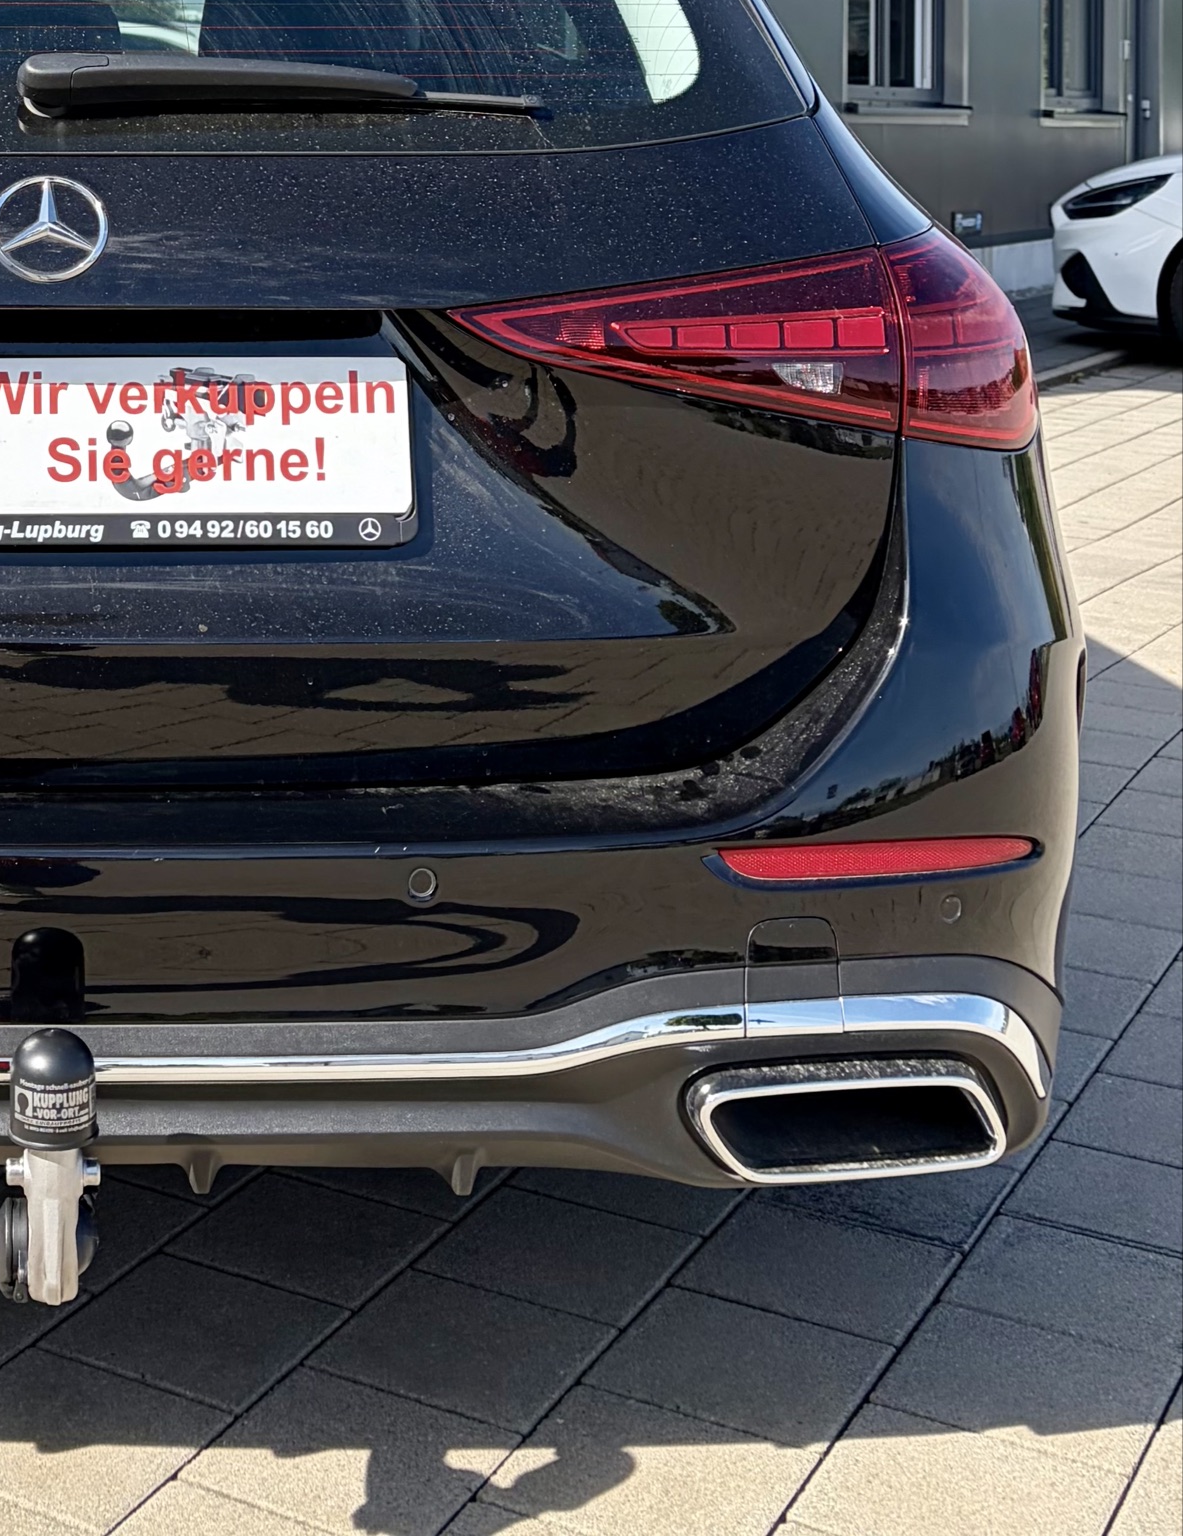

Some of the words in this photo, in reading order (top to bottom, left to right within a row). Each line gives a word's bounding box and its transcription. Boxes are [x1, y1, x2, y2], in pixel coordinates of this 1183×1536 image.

[86, 370, 396, 425] verkuppeln
[47, 437, 132, 483] Sie
[153, 437, 326, 494] gerne!
[33, 1087, 89, 1109] KUPPLUNG
